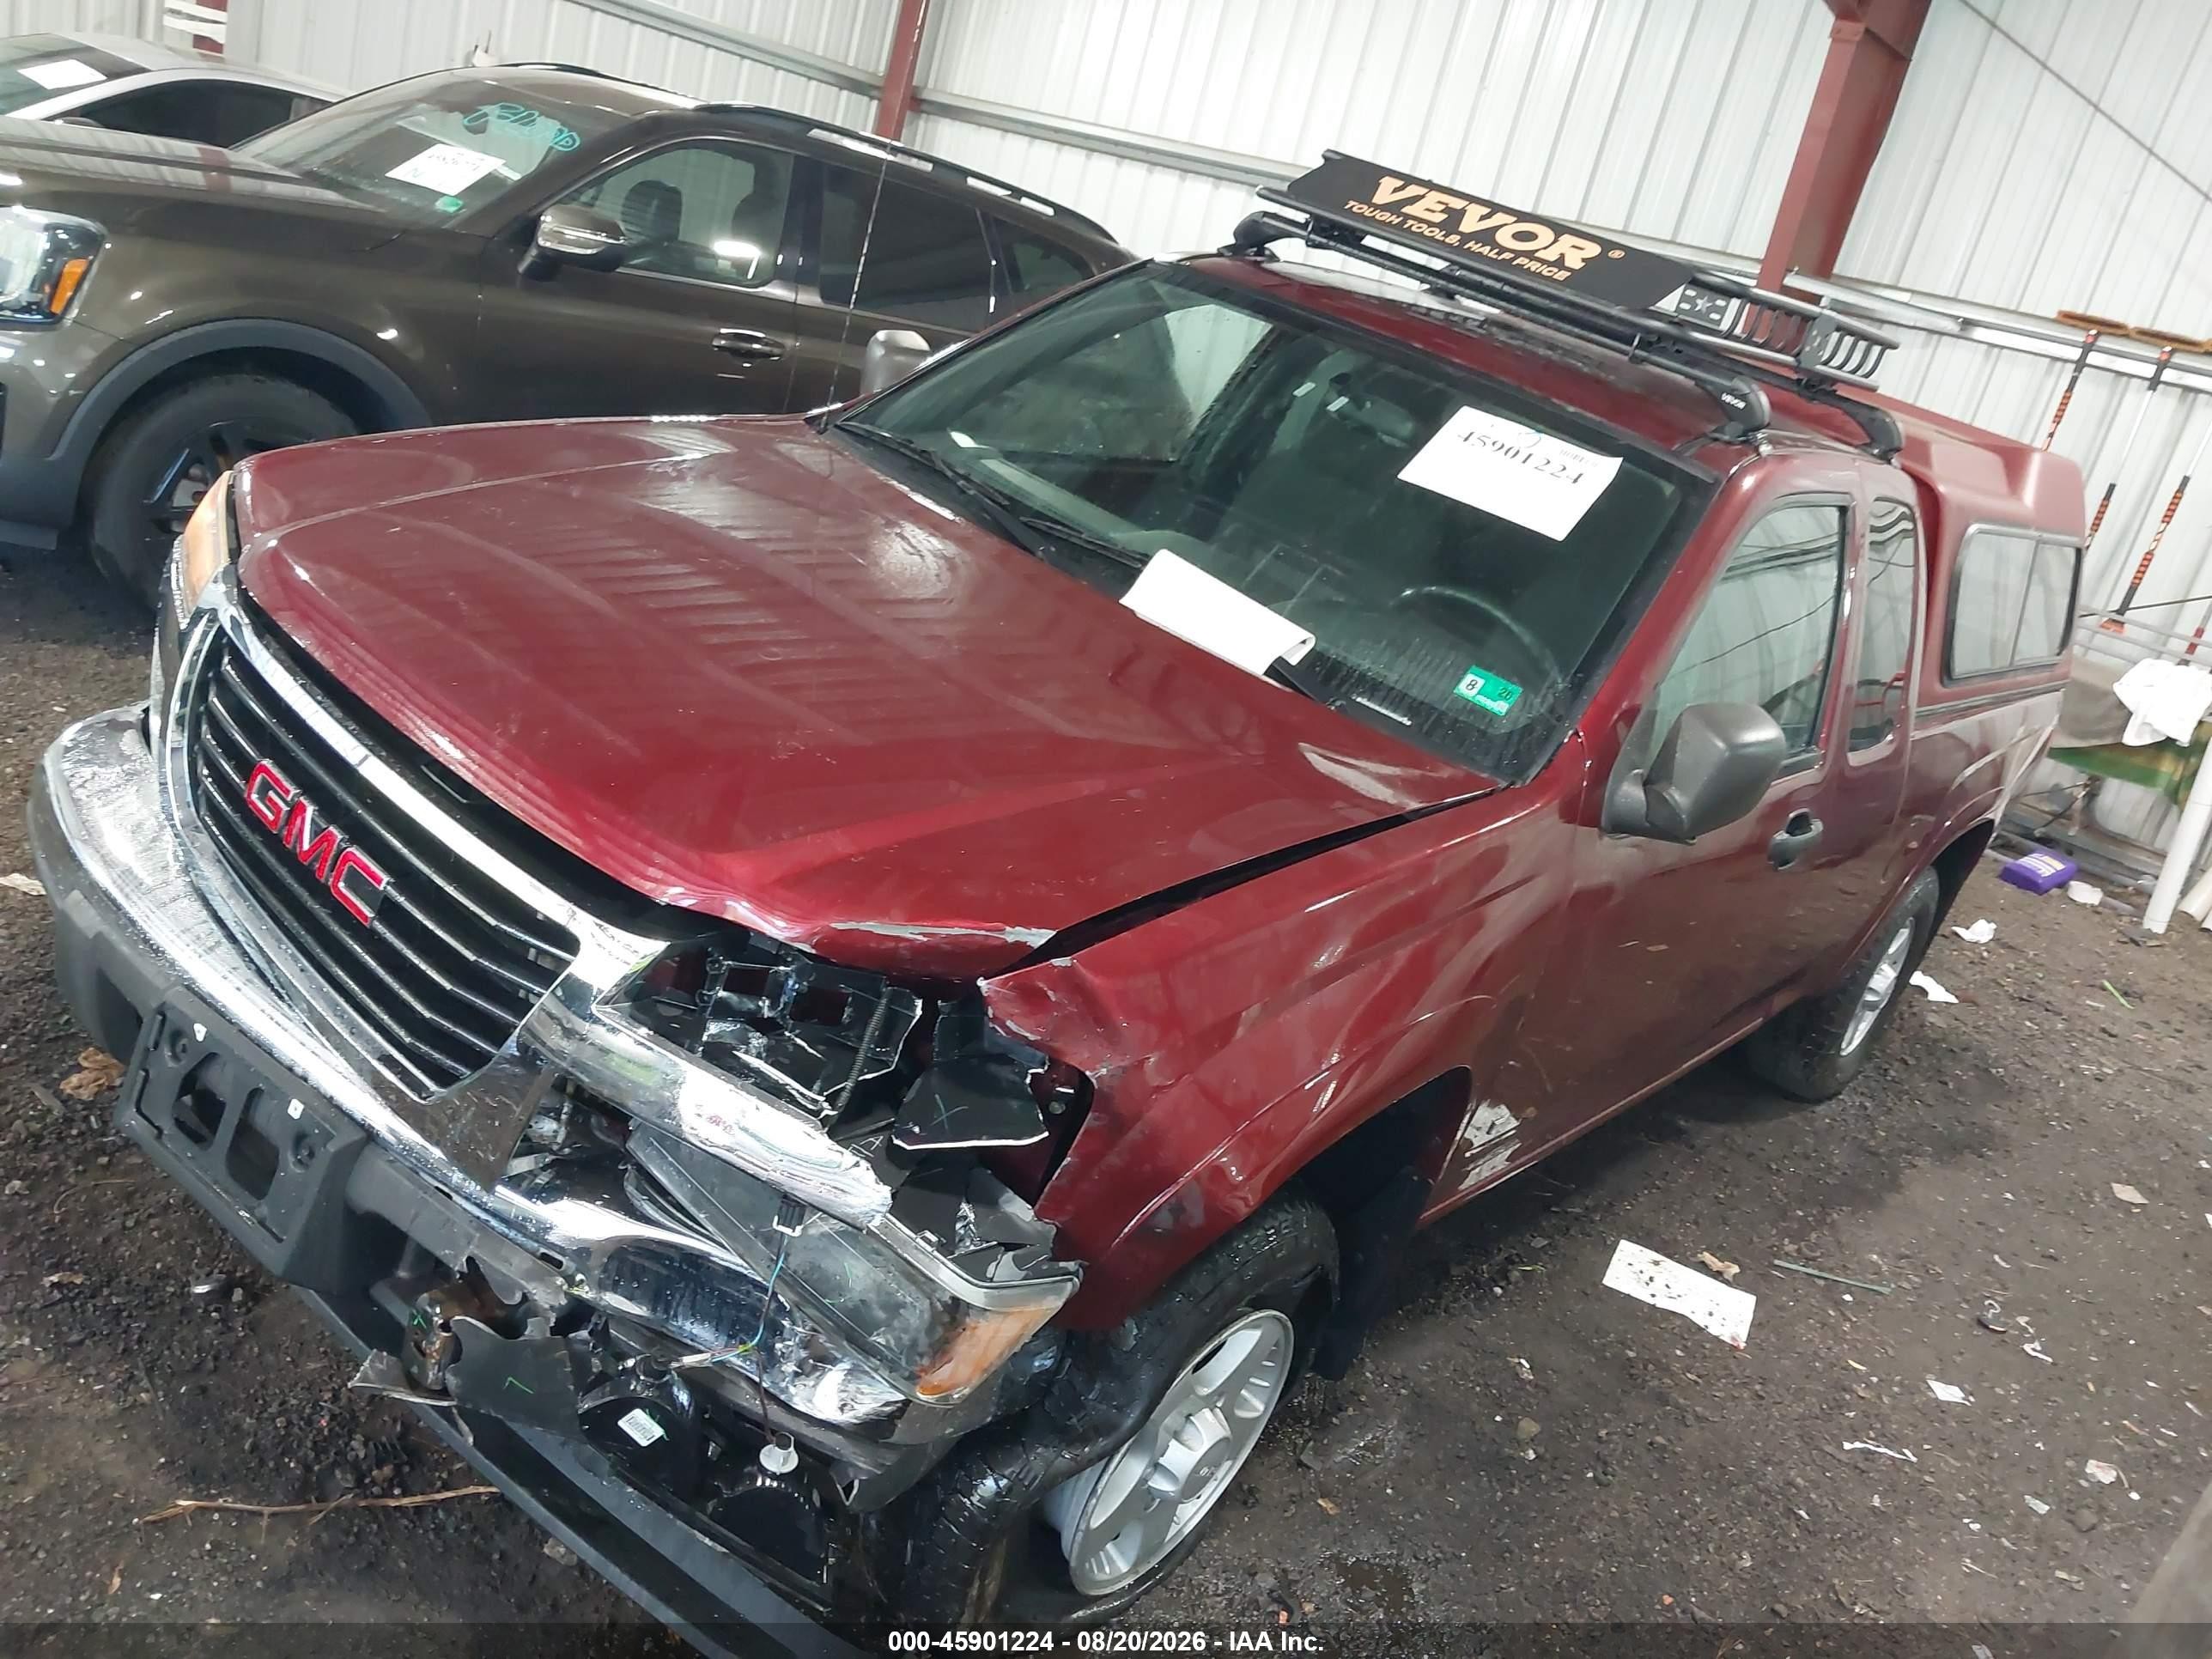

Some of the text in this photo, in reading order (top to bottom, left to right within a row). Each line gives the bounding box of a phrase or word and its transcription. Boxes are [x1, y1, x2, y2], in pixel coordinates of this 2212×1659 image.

[1344, 200, 1571, 282] TOUGH TOOLS, HALF PRICE
[1372, 176, 1602, 270] VEVOR
[1457, 431, 1584, 484] 45901224
[1465, 679, 1478, 691] 8
[244, 759, 393, 928] GMC
